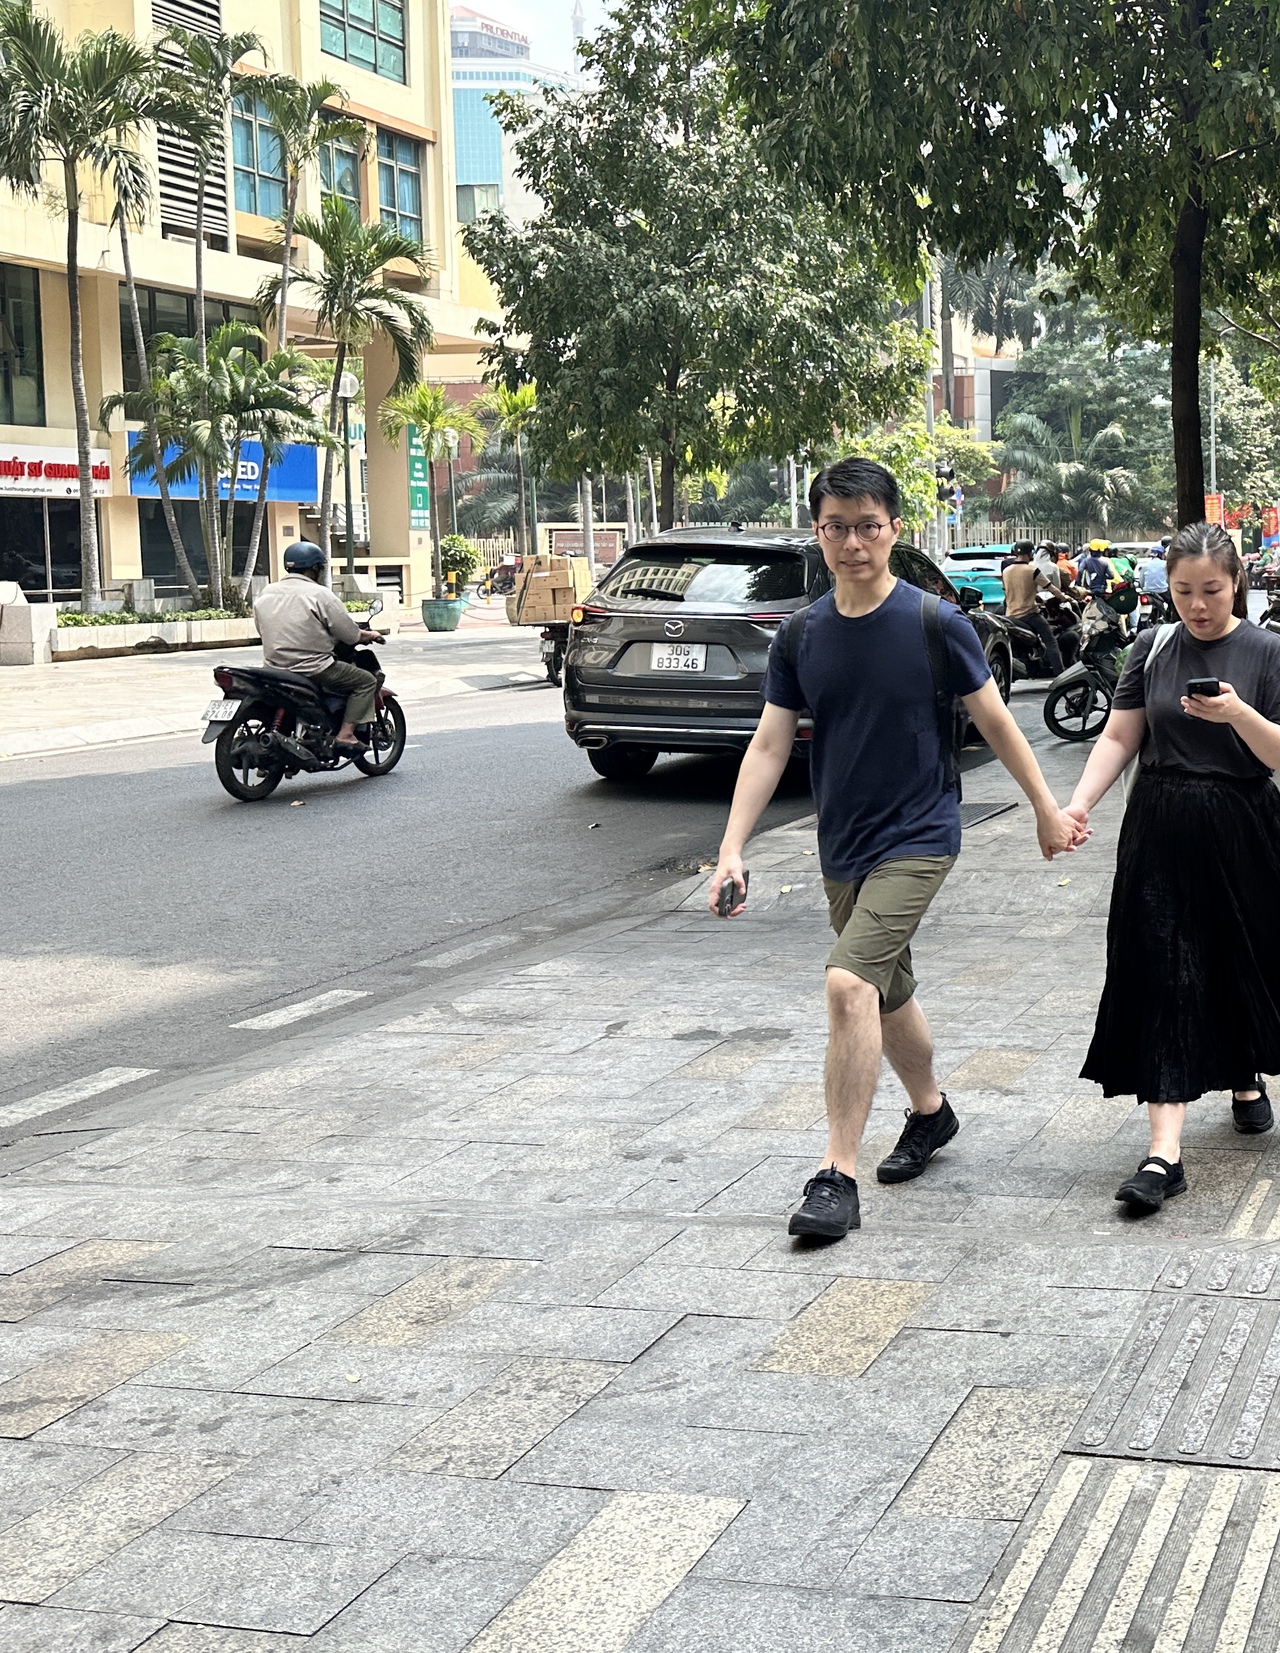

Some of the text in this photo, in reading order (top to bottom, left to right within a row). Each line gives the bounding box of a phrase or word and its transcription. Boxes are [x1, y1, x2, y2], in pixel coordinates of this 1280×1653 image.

[481, 21, 532, 46] PRUDENTIAL
[27, 459, 43, 478] SƯ
[44, 462, 79, 479] QUAN
[667, 645, 691, 657] 30G
[656, 657, 699, 669] 833.46
